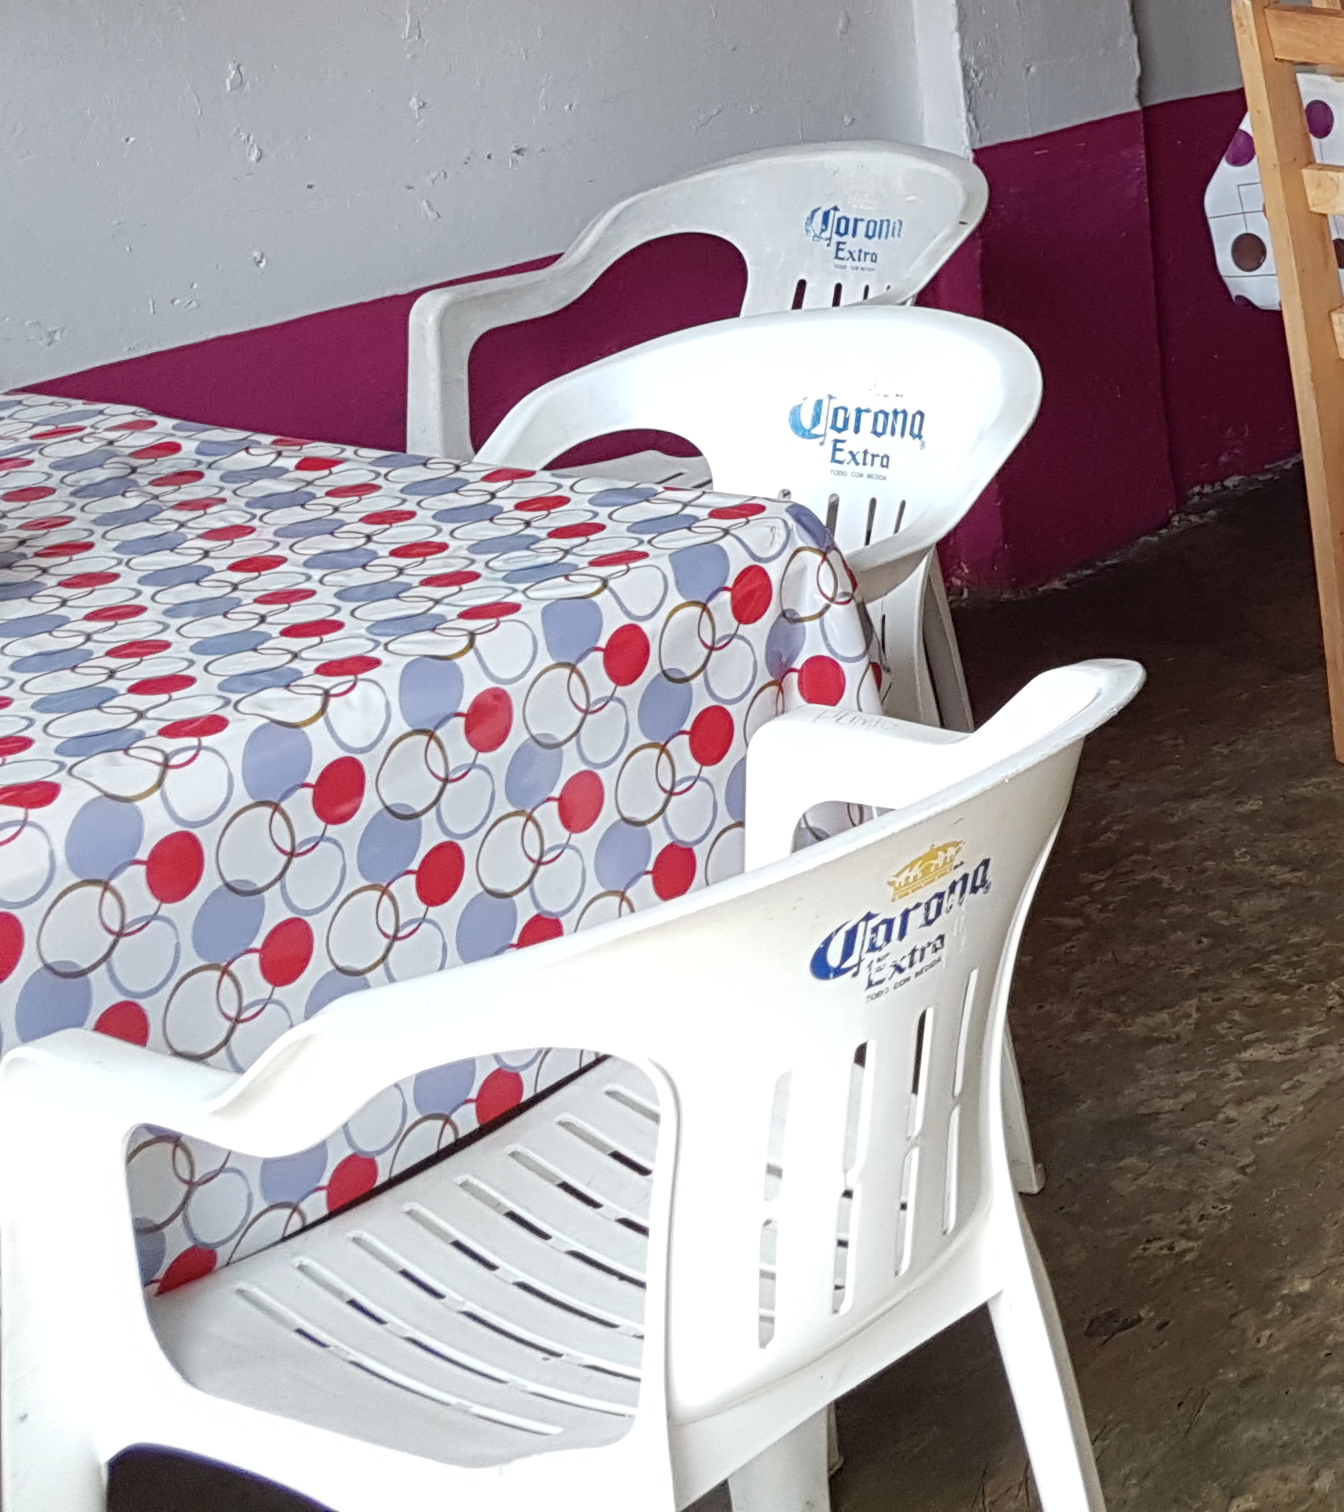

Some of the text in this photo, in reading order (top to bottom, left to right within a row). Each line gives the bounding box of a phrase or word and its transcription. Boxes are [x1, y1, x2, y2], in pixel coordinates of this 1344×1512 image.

[804, 205, 903, 247] Corona
[834, 240, 878, 264] Extra
[788, 394, 926, 446] Corona
[830, 438, 890, 469] Extra
[809, 857, 992, 980] Corona
[864, 934, 946, 991] Extra
